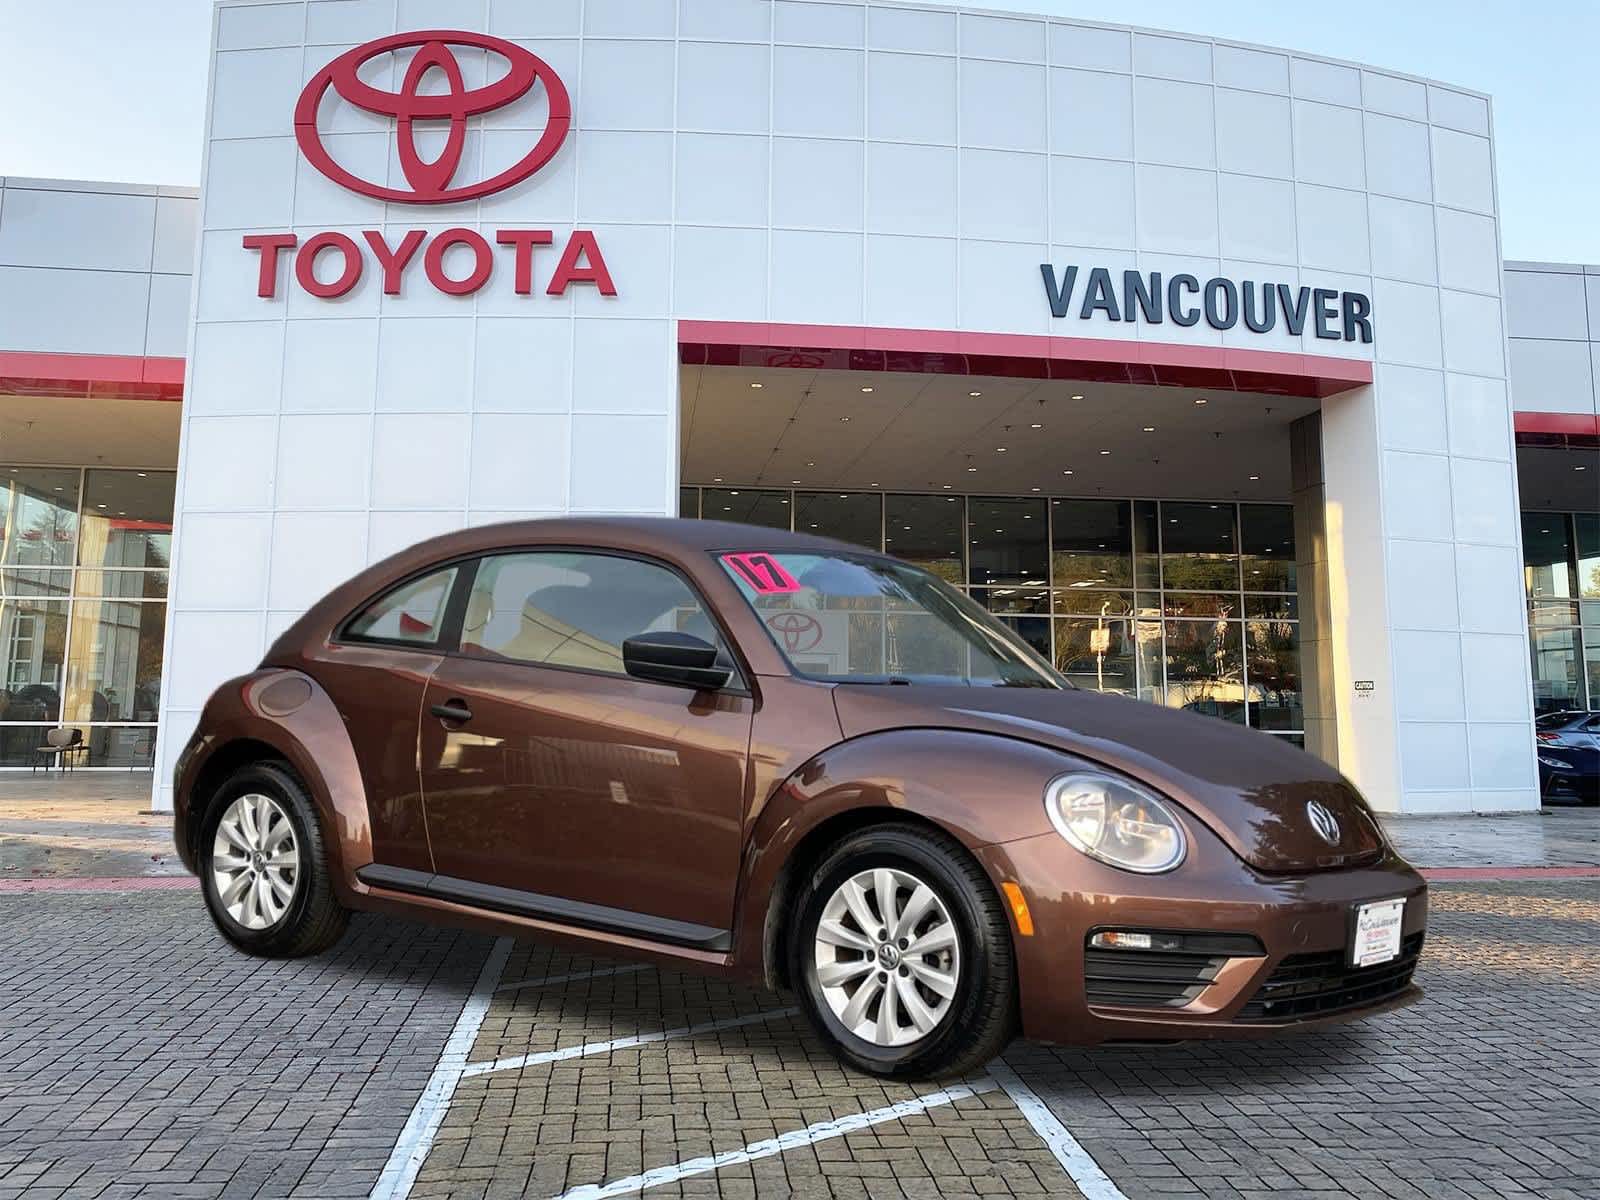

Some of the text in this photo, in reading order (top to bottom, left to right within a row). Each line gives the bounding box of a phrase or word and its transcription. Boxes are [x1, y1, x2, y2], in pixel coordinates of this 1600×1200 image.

[243, 228, 617, 298] TOYOTA
[1040, 264, 1373, 344] VANCOUVER
[730, 556, 788, 590] 17
